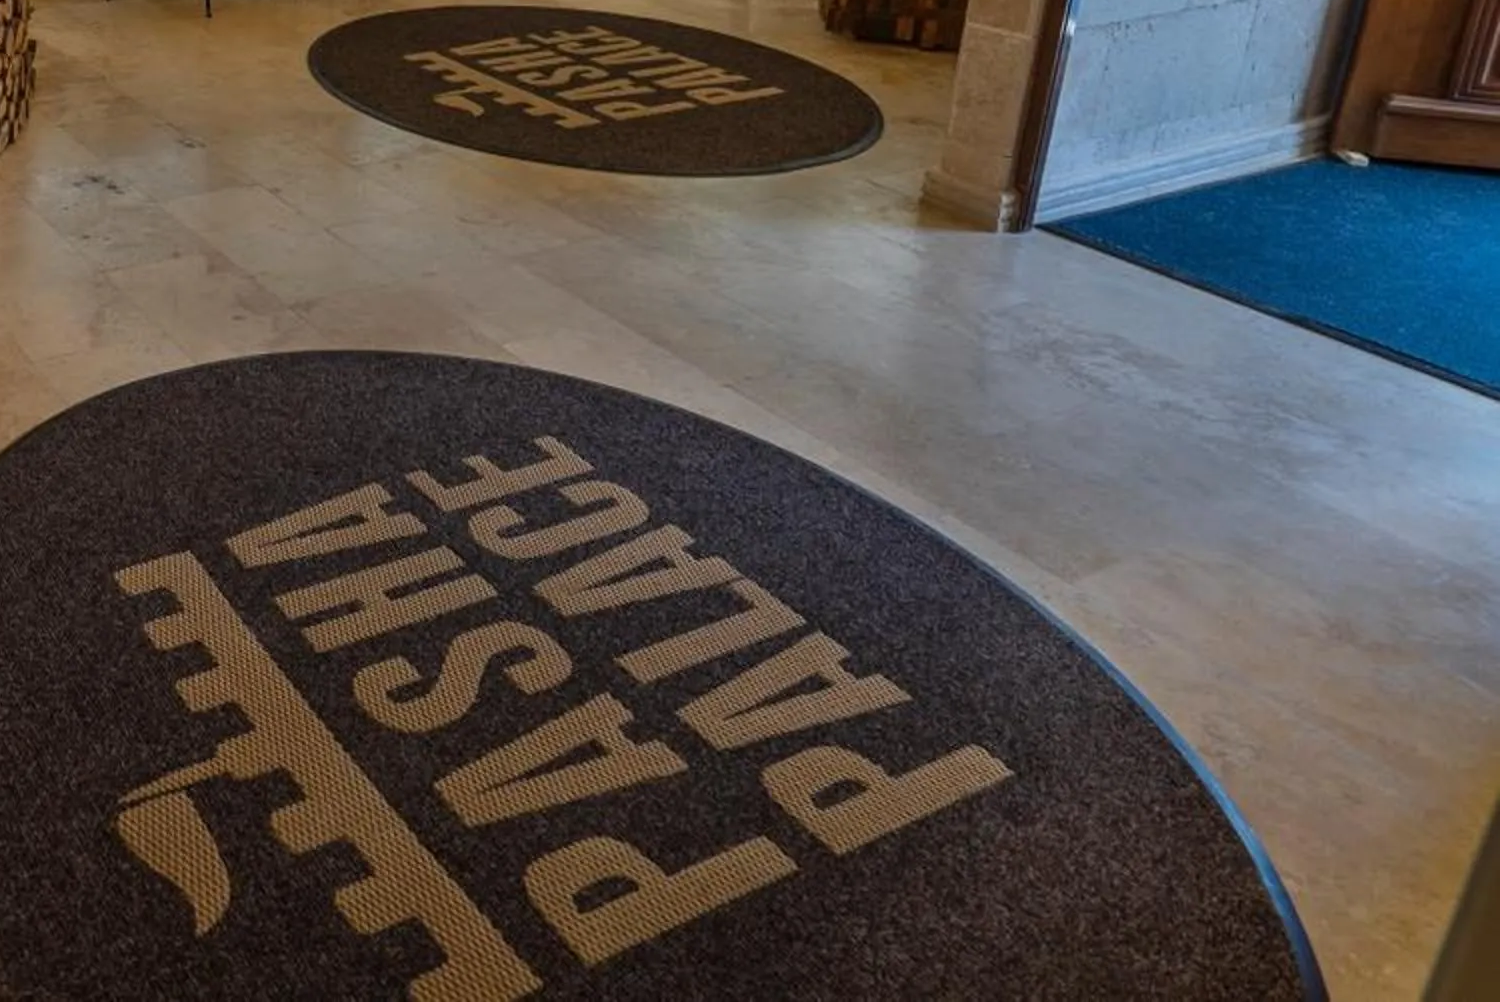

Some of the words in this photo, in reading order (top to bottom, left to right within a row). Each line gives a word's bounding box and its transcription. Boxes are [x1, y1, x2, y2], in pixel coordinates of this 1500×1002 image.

[453, 38, 696, 121] PASHA
[526, 25, 785, 105] PALACE
[224, 481, 799, 968] PASHA
[405, 434, 1016, 855] PALACE
